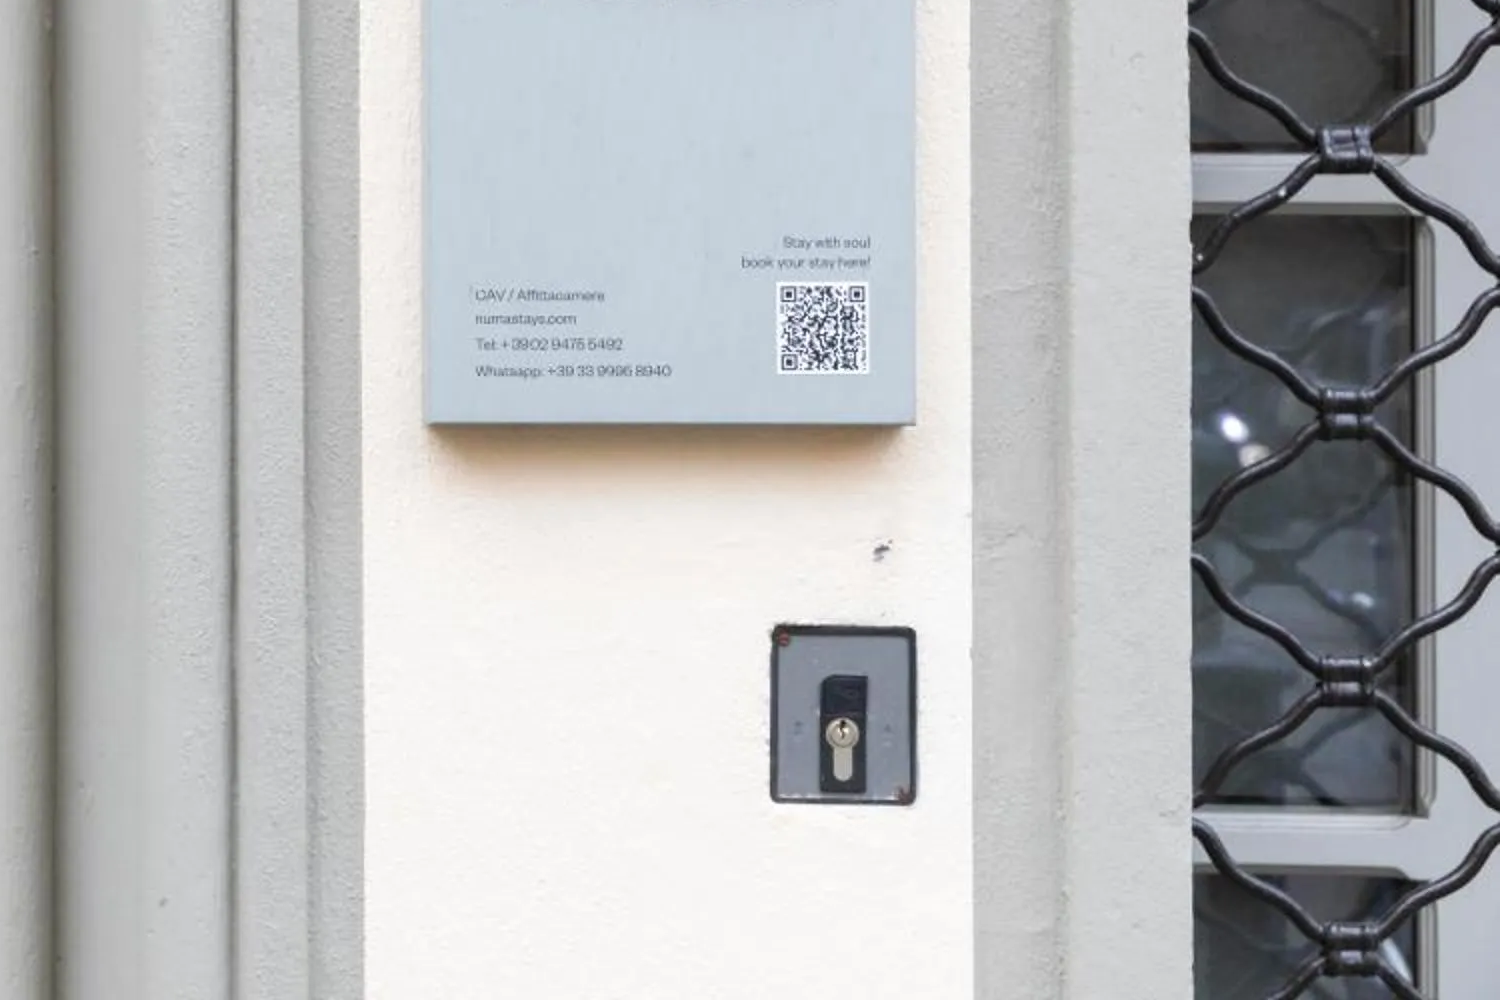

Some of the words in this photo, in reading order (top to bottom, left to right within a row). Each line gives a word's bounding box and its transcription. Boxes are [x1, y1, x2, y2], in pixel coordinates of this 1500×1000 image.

[783, 236, 813, 251] Stay
[815, 236, 841, 250] with
[844, 236, 871, 250] soul
[741, 255, 774, 269] book
[778, 257, 805, 271] your
[809, 257, 835, 271] stay
[475, 314, 577, 327] numastays.com
